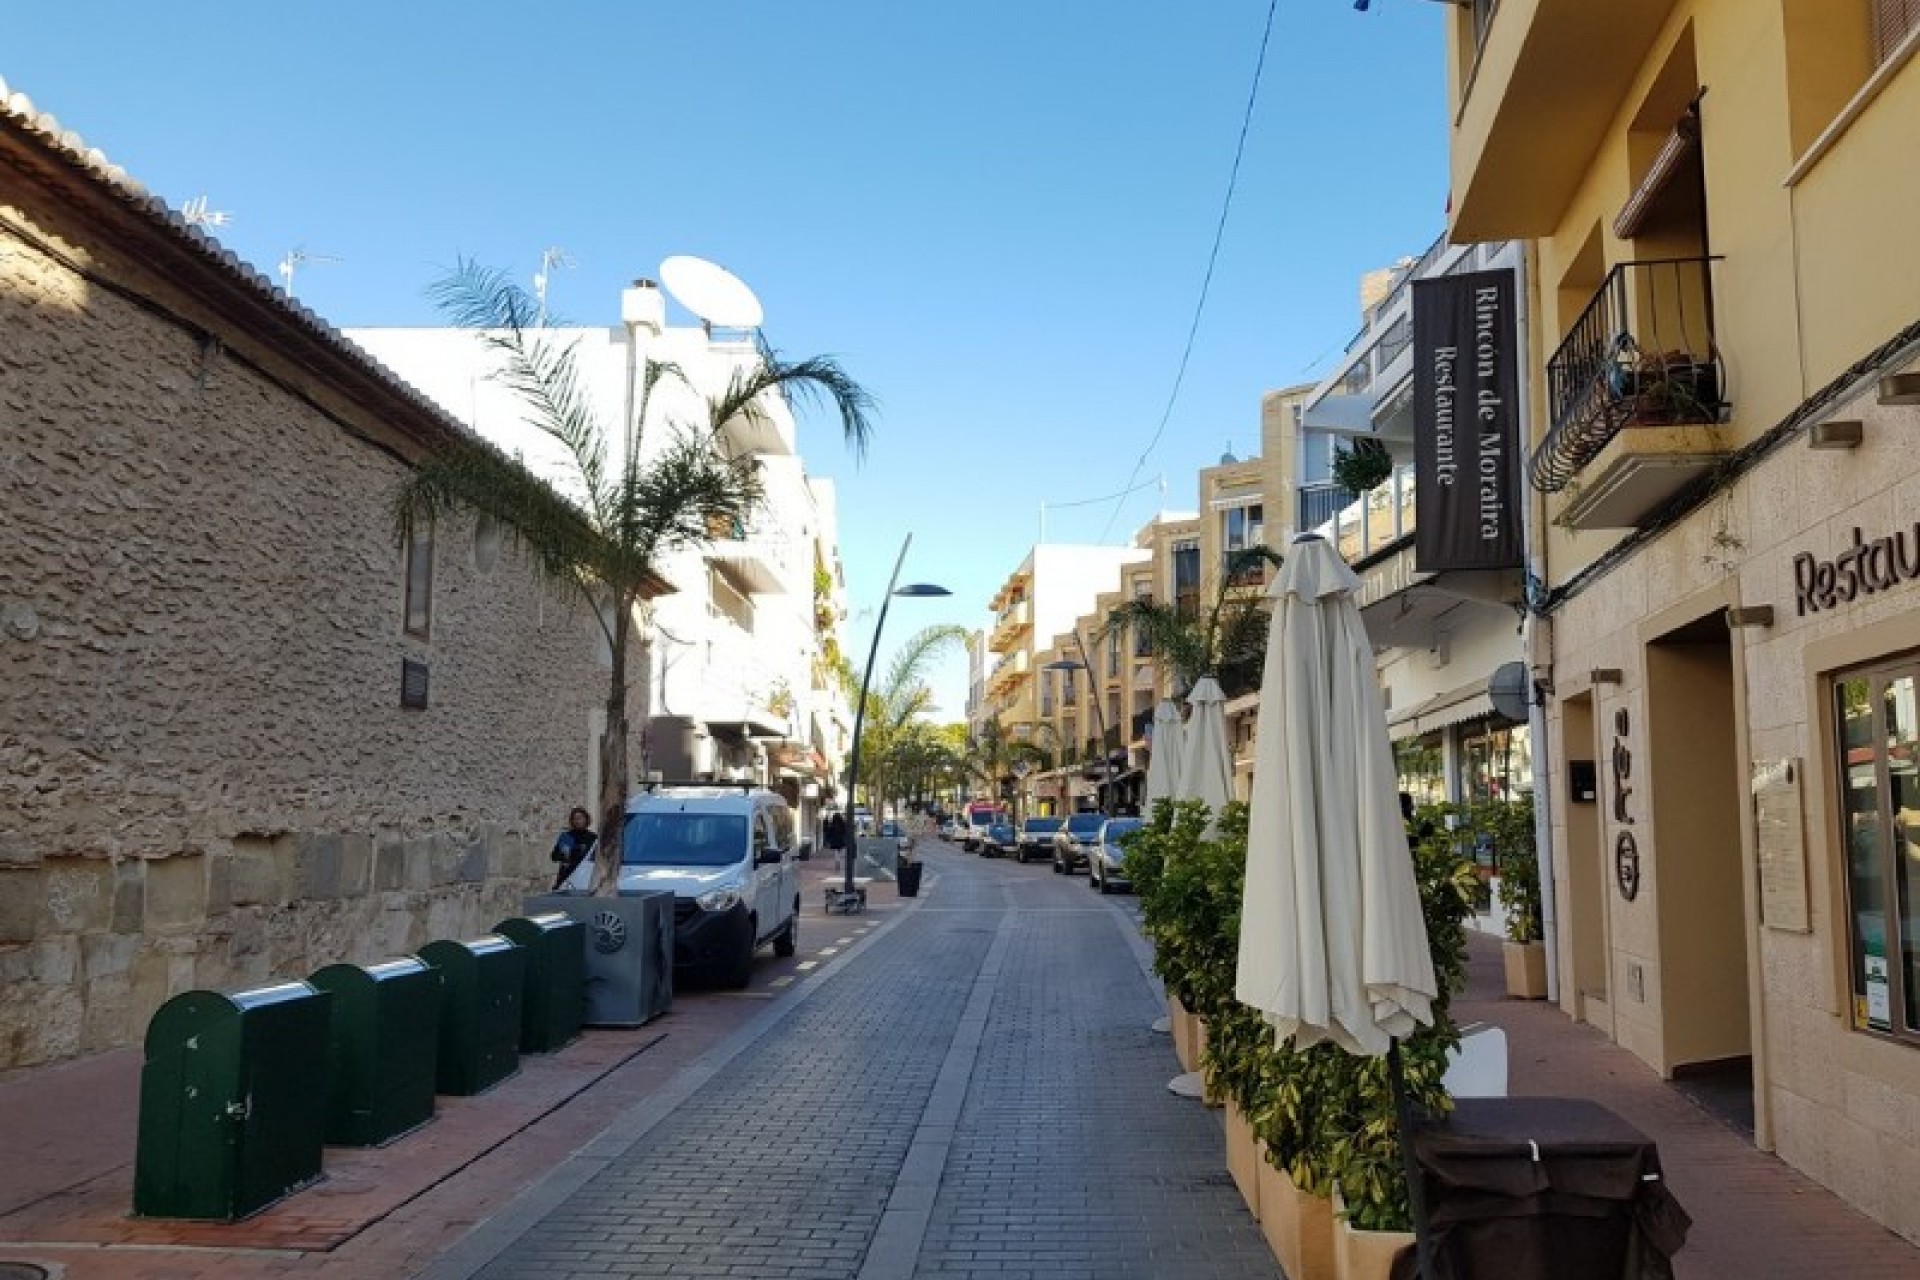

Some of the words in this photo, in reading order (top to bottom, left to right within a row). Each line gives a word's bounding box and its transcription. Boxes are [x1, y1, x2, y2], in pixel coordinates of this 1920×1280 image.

[1475, 286, 1499, 377] Rincón
[1434, 346, 1457, 486] Restaurante
[1477, 389, 1501, 420] de
[1478, 433, 1503, 540] Moraira
[1793, 522, 1920, 616] Restau
